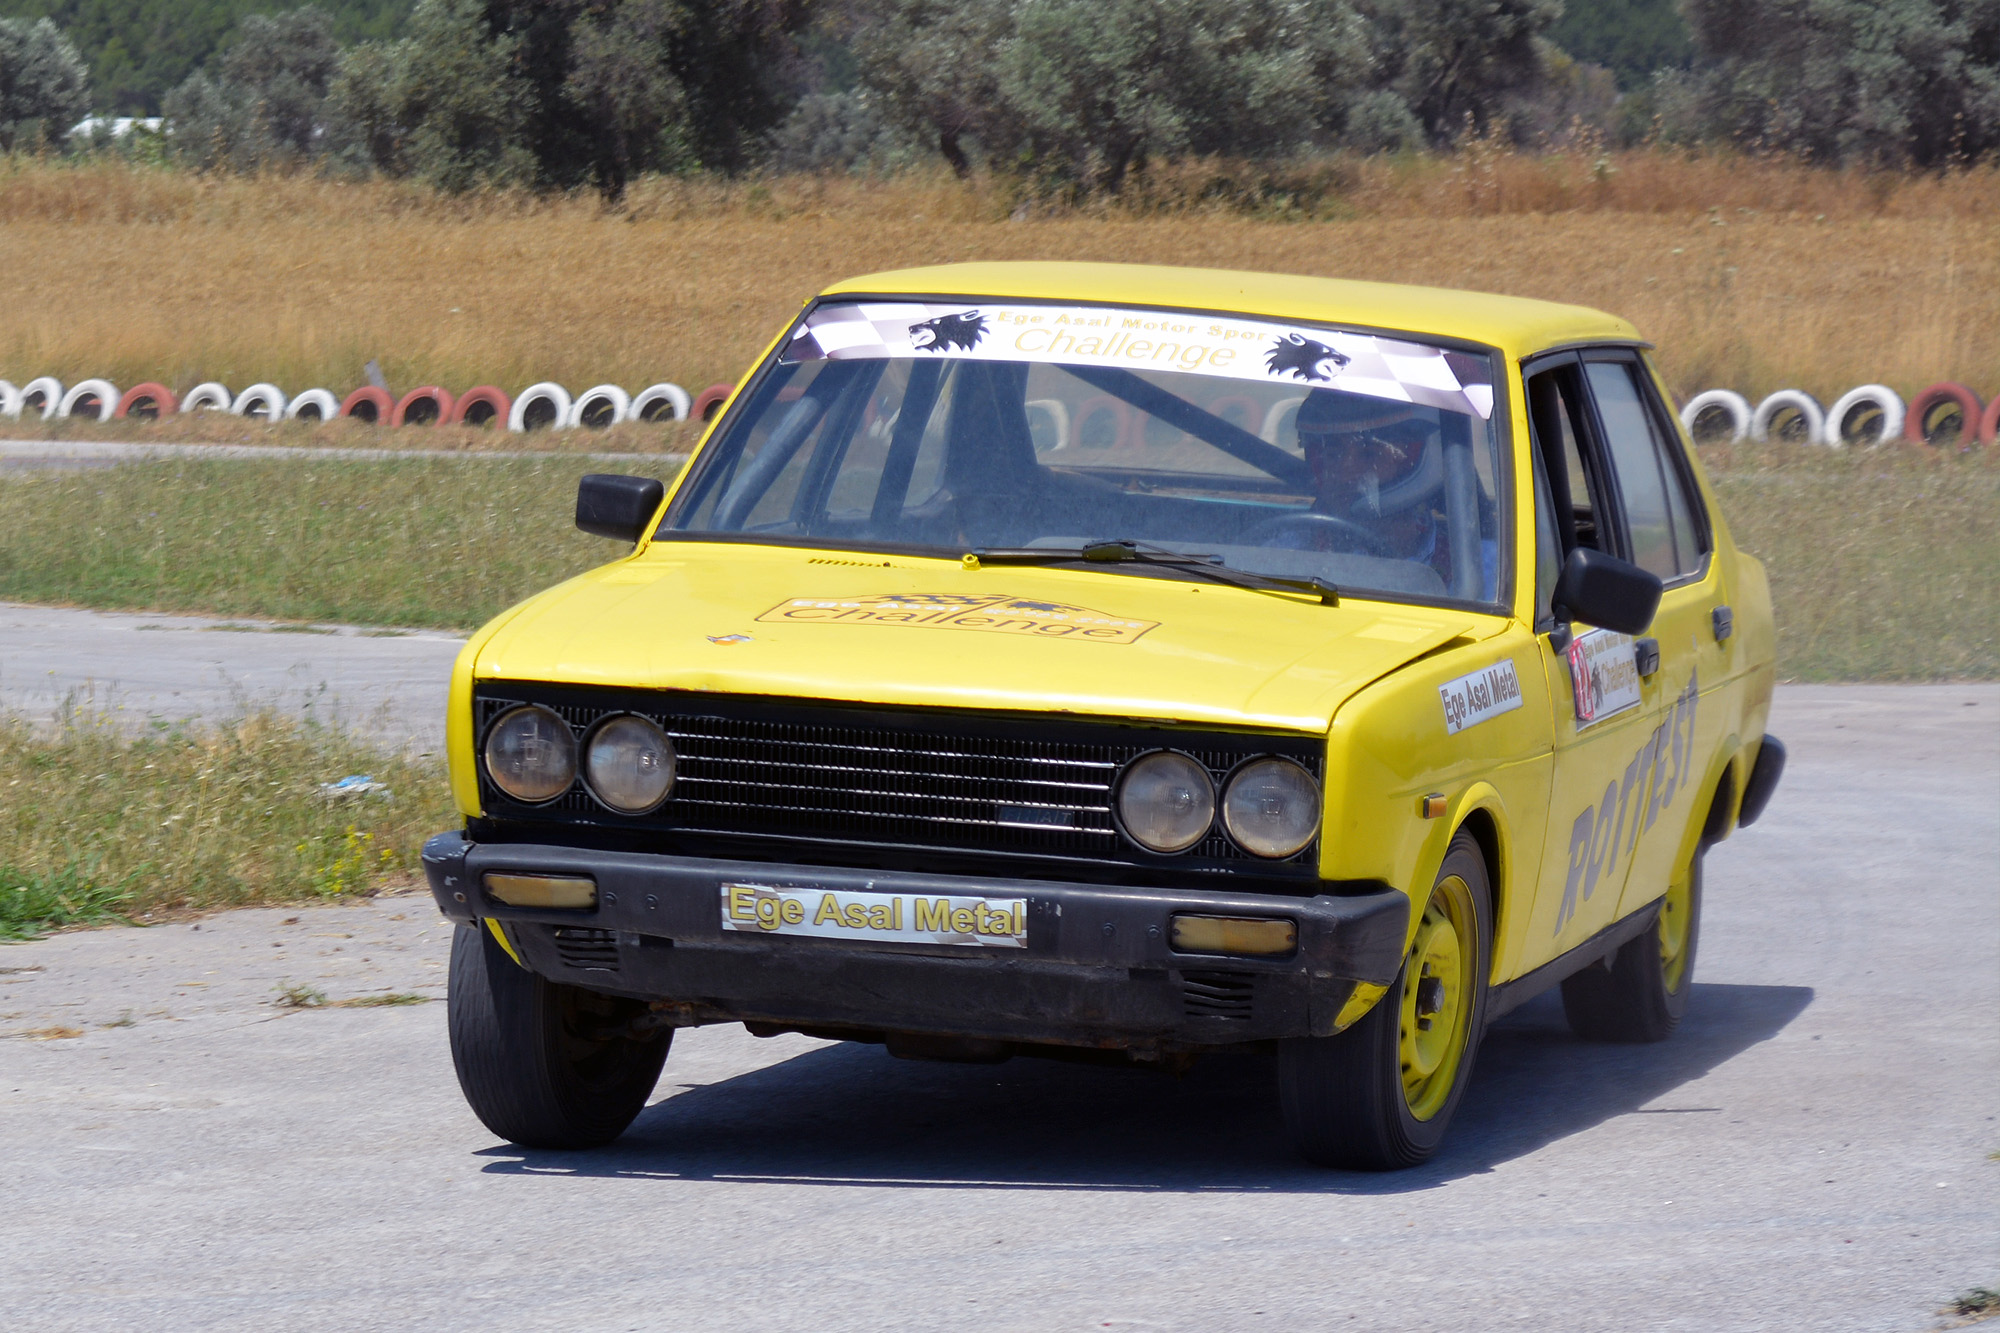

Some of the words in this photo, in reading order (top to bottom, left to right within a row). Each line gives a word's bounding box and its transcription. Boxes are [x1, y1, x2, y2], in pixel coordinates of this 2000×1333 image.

[997, 311, 1045, 326] Ege
[1053, 312, 1111, 328] Asal
[1121, 315, 1198, 335] Motor
[1014, 327, 1237, 371] Challenge
[783, 607, 1125, 637] Challenge
[1440, 688, 1466, 730] Ege
[1465, 680, 1492, 716] Asal
[1488, 663, 1520, 705] Metal
[1553, 664, 1699, 938] ROTTEST
[728, 886, 804, 931] Ege
[814, 892, 903, 931] Asal
[914, 897, 1022, 936] Metal
